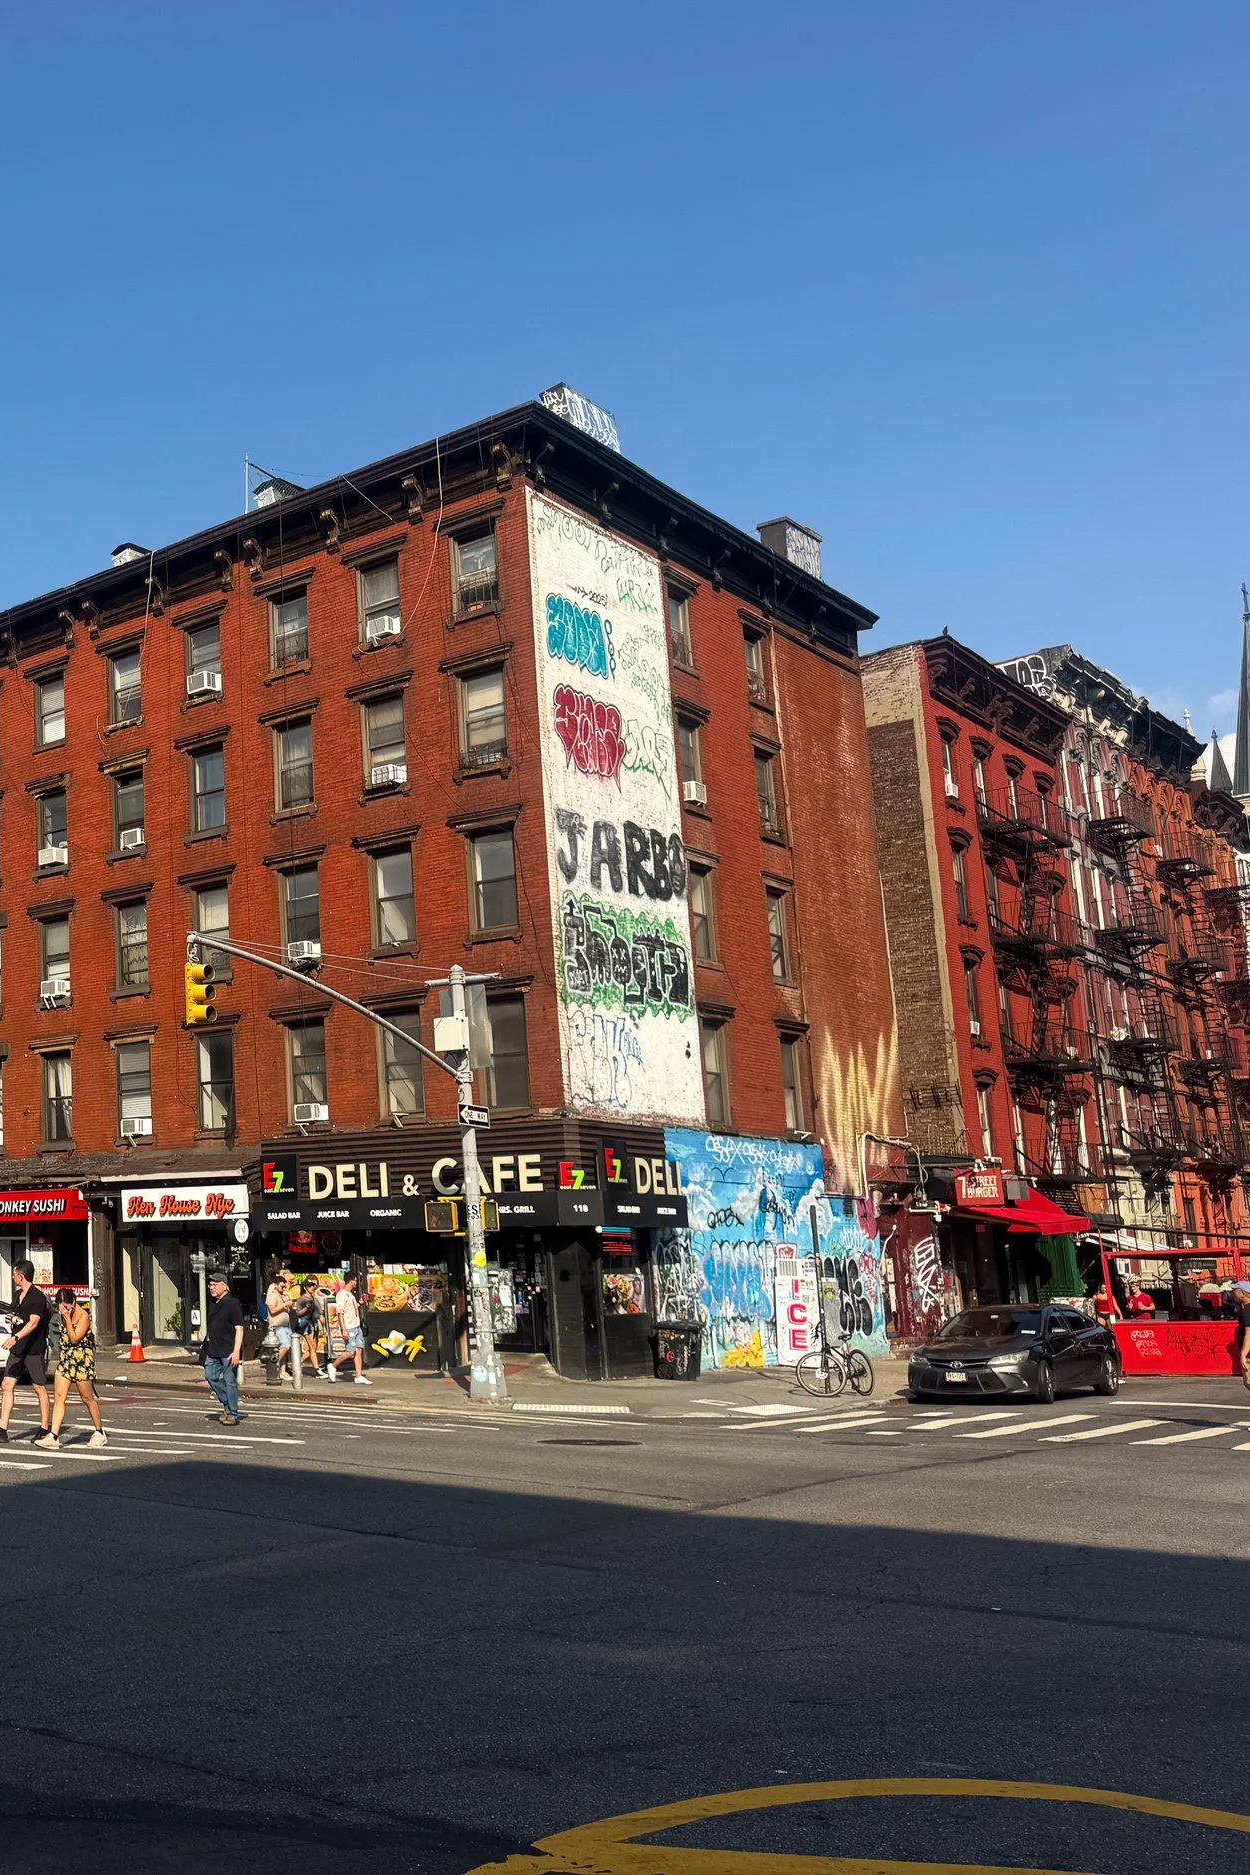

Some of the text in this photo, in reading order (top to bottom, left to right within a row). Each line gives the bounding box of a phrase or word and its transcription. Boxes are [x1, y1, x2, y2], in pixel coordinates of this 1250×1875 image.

[464, 1110, 486, 1122] ONE WAY
[263, 1162, 284, 1193] E7
[308, 1162, 389, 1200] DELI
[402, 1174, 420, 1197] &
[559, 1161, 585, 1190] E7
[634, 1156, 682, 1196] DELI
[971, 1175, 997, 1187] STREET
[967, 1187, 999, 1199] BURGER
[33, 1198, 65, 1212] SUSHI
[127, 1192, 235, 1219] Hen House Nyc
[513, 1205, 536, 1214] GRILL
[266, 1211, 301, 1220] SALAD BAR
[316, 1210, 350, 1219] JUICE BAR
[370, 1208, 402, 1217] ORGANIC
[192, 1311, 199, 1320] A
[787, 1279, 808, 1350] ICE
